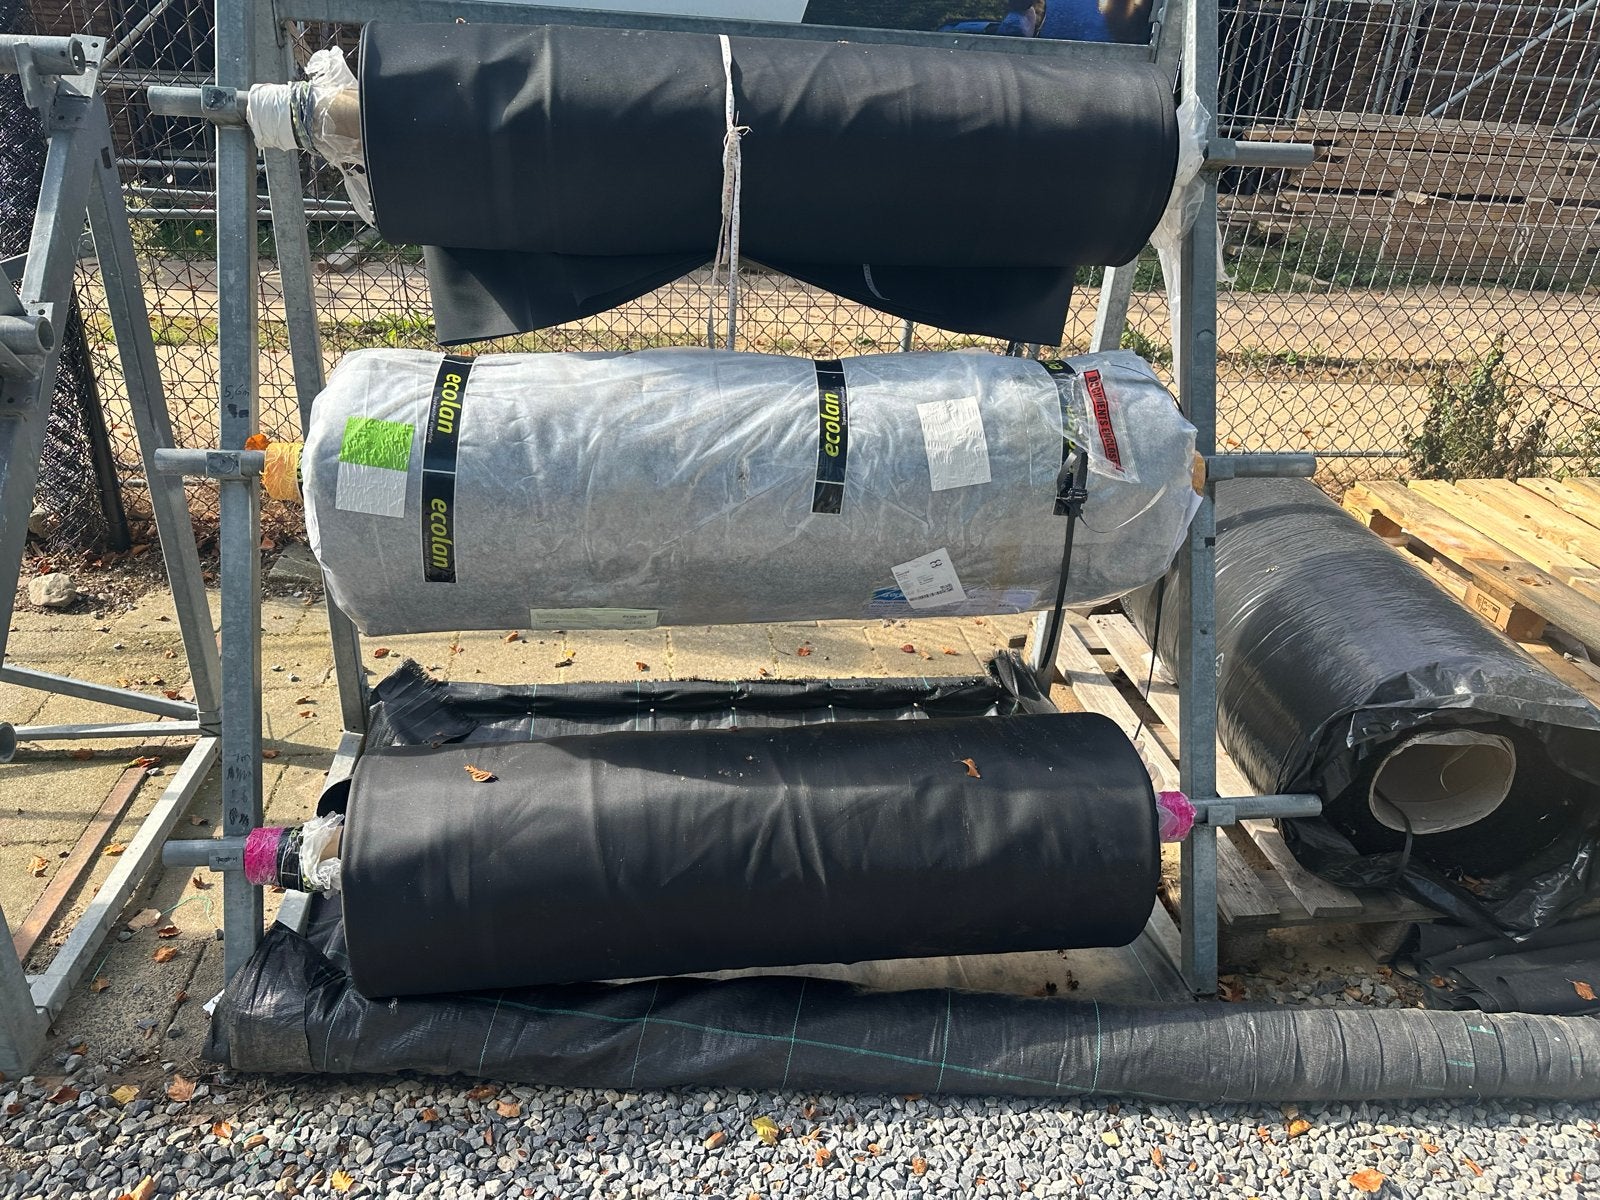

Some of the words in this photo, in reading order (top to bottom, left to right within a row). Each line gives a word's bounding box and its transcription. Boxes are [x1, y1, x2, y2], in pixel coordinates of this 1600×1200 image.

[437, 373, 462, 434] ecolan
[820, 392, 841, 457] ecolan
[1101, 427, 1119, 463] ENCLOS
[430, 498, 453, 568] ecolan
